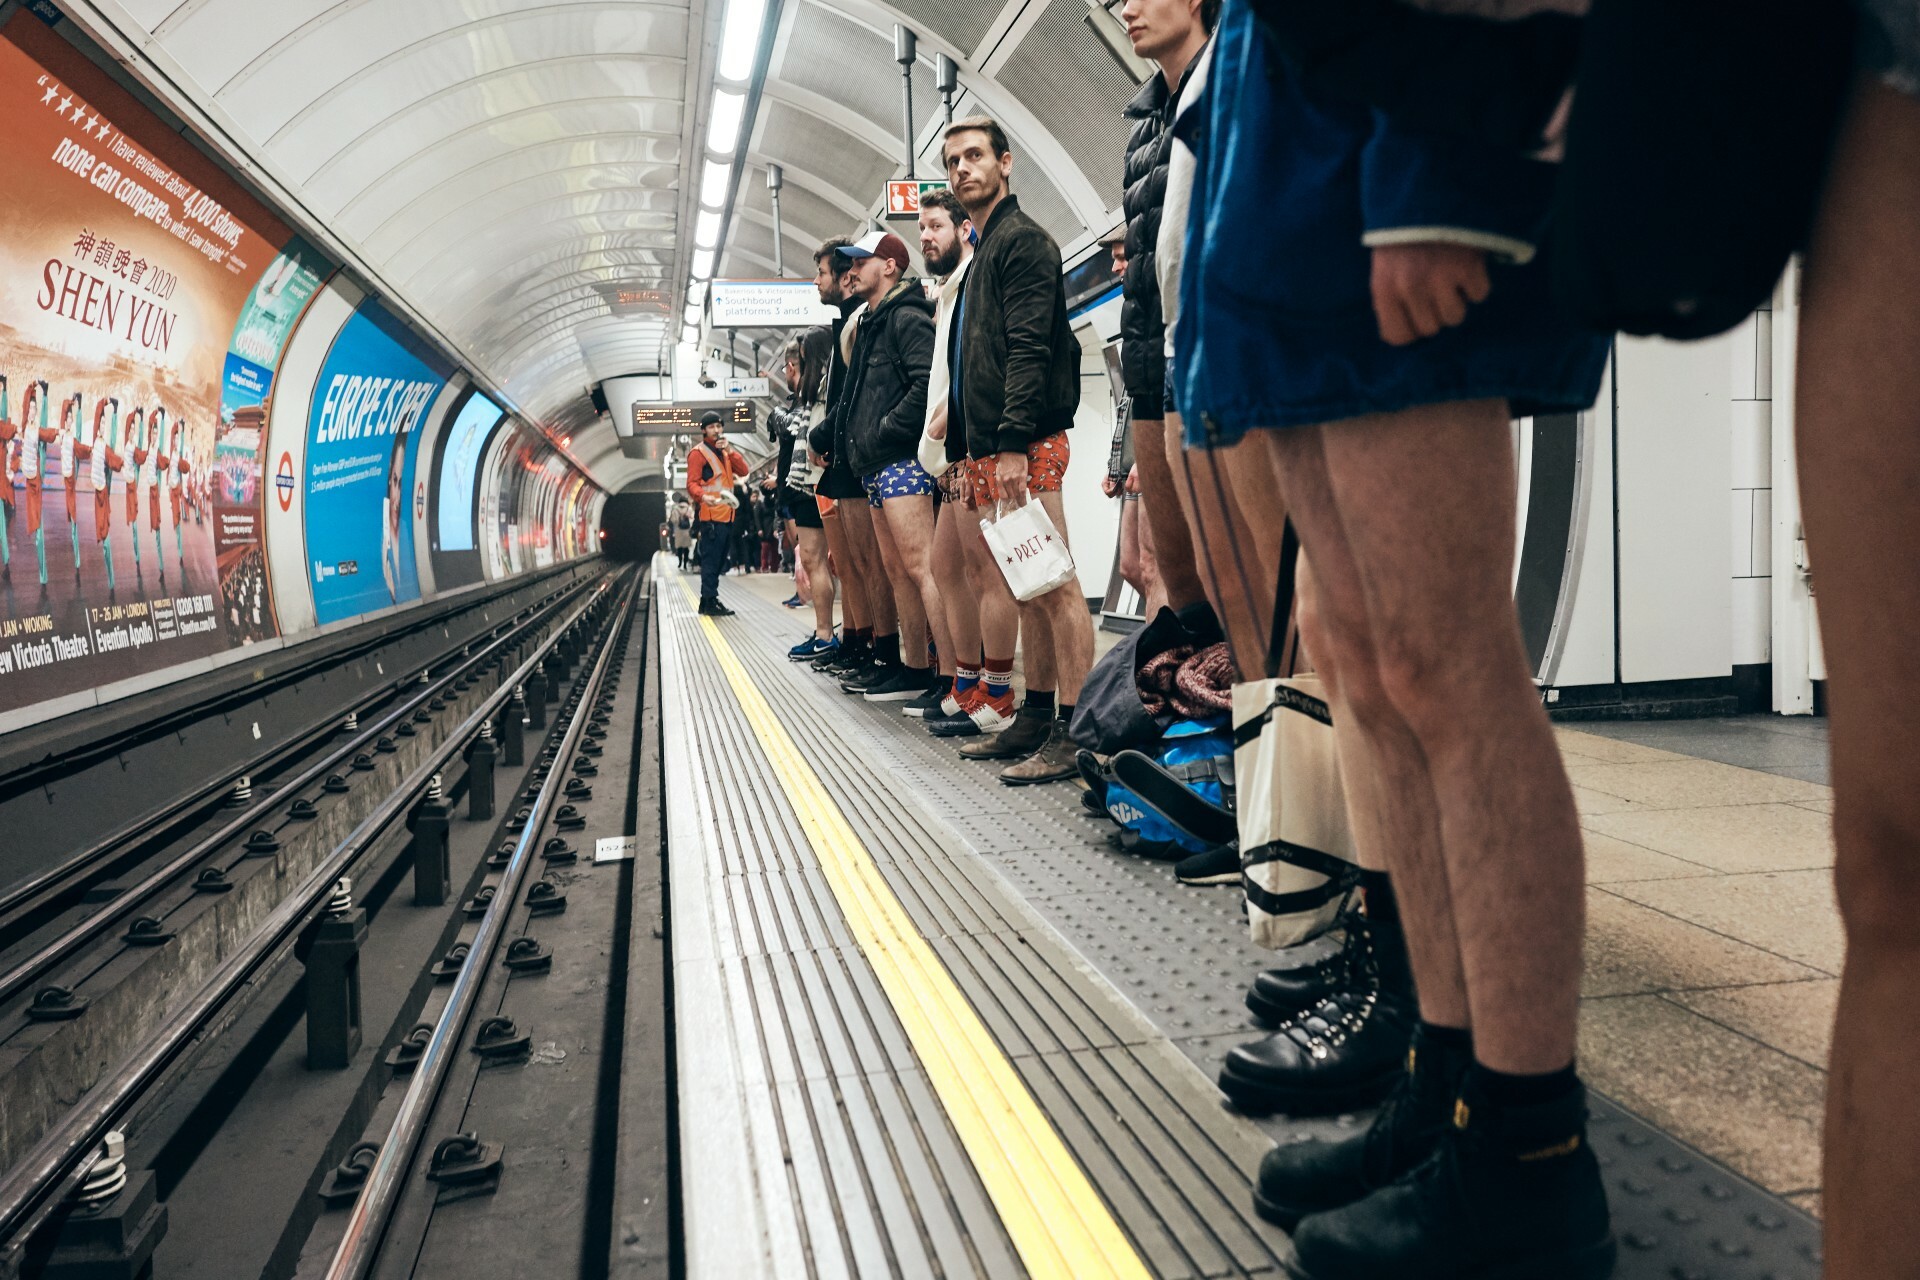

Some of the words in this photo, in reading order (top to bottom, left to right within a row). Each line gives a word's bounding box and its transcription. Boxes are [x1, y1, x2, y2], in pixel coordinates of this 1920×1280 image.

[107, 133, 118, 148] I
[112, 136, 136, 162] have
[52, 137, 96, 178] none
[90, 162, 121, 194] can
[132, 157, 172, 186] reviewed
[115, 178, 169, 224] compare
[165, 177, 191, 200] about
[162, 213, 172, 230] to
[183, 190, 222, 227] 4,000
[170, 221, 191, 241] what
[186, 229, 194, 242] I
[189, 234, 204, 249] saw
[210, 212, 244, 250] shows,
[73, 227, 148, 285] 神韻晚會
[144, 265, 178, 301] 2020
[725, 297, 782, 305] Southbound
[766, 287, 793, 295] Victoria
[37, 258, 124, 334] SHEN
[126, 295, 178, 354] YUN
[725, 308, 772, 316] platforms
[316, 374, 392, 443] EUROPE
[374, 379, 405, 436] IS
[389, 380, 438, 435] OPEN
[1014, 535, 1043, 562] PRET
[92, 608, 98, 623] 17
[103, 606, 112, 621] 26
[112, 604, 122, 620] JAN
[126, 602, 148, 618] LONDON
[177, 597, 193, 616] 0208
[3, 620, 18, 638] JAN
[23, 614, 53, 634] WOKING
[96, 625, 130, 653] Eventim
[129, 621, 153, 649] Apollo
[12, 638, 54, 671] Victoria
[52, 633, 89, 662] Theatre
